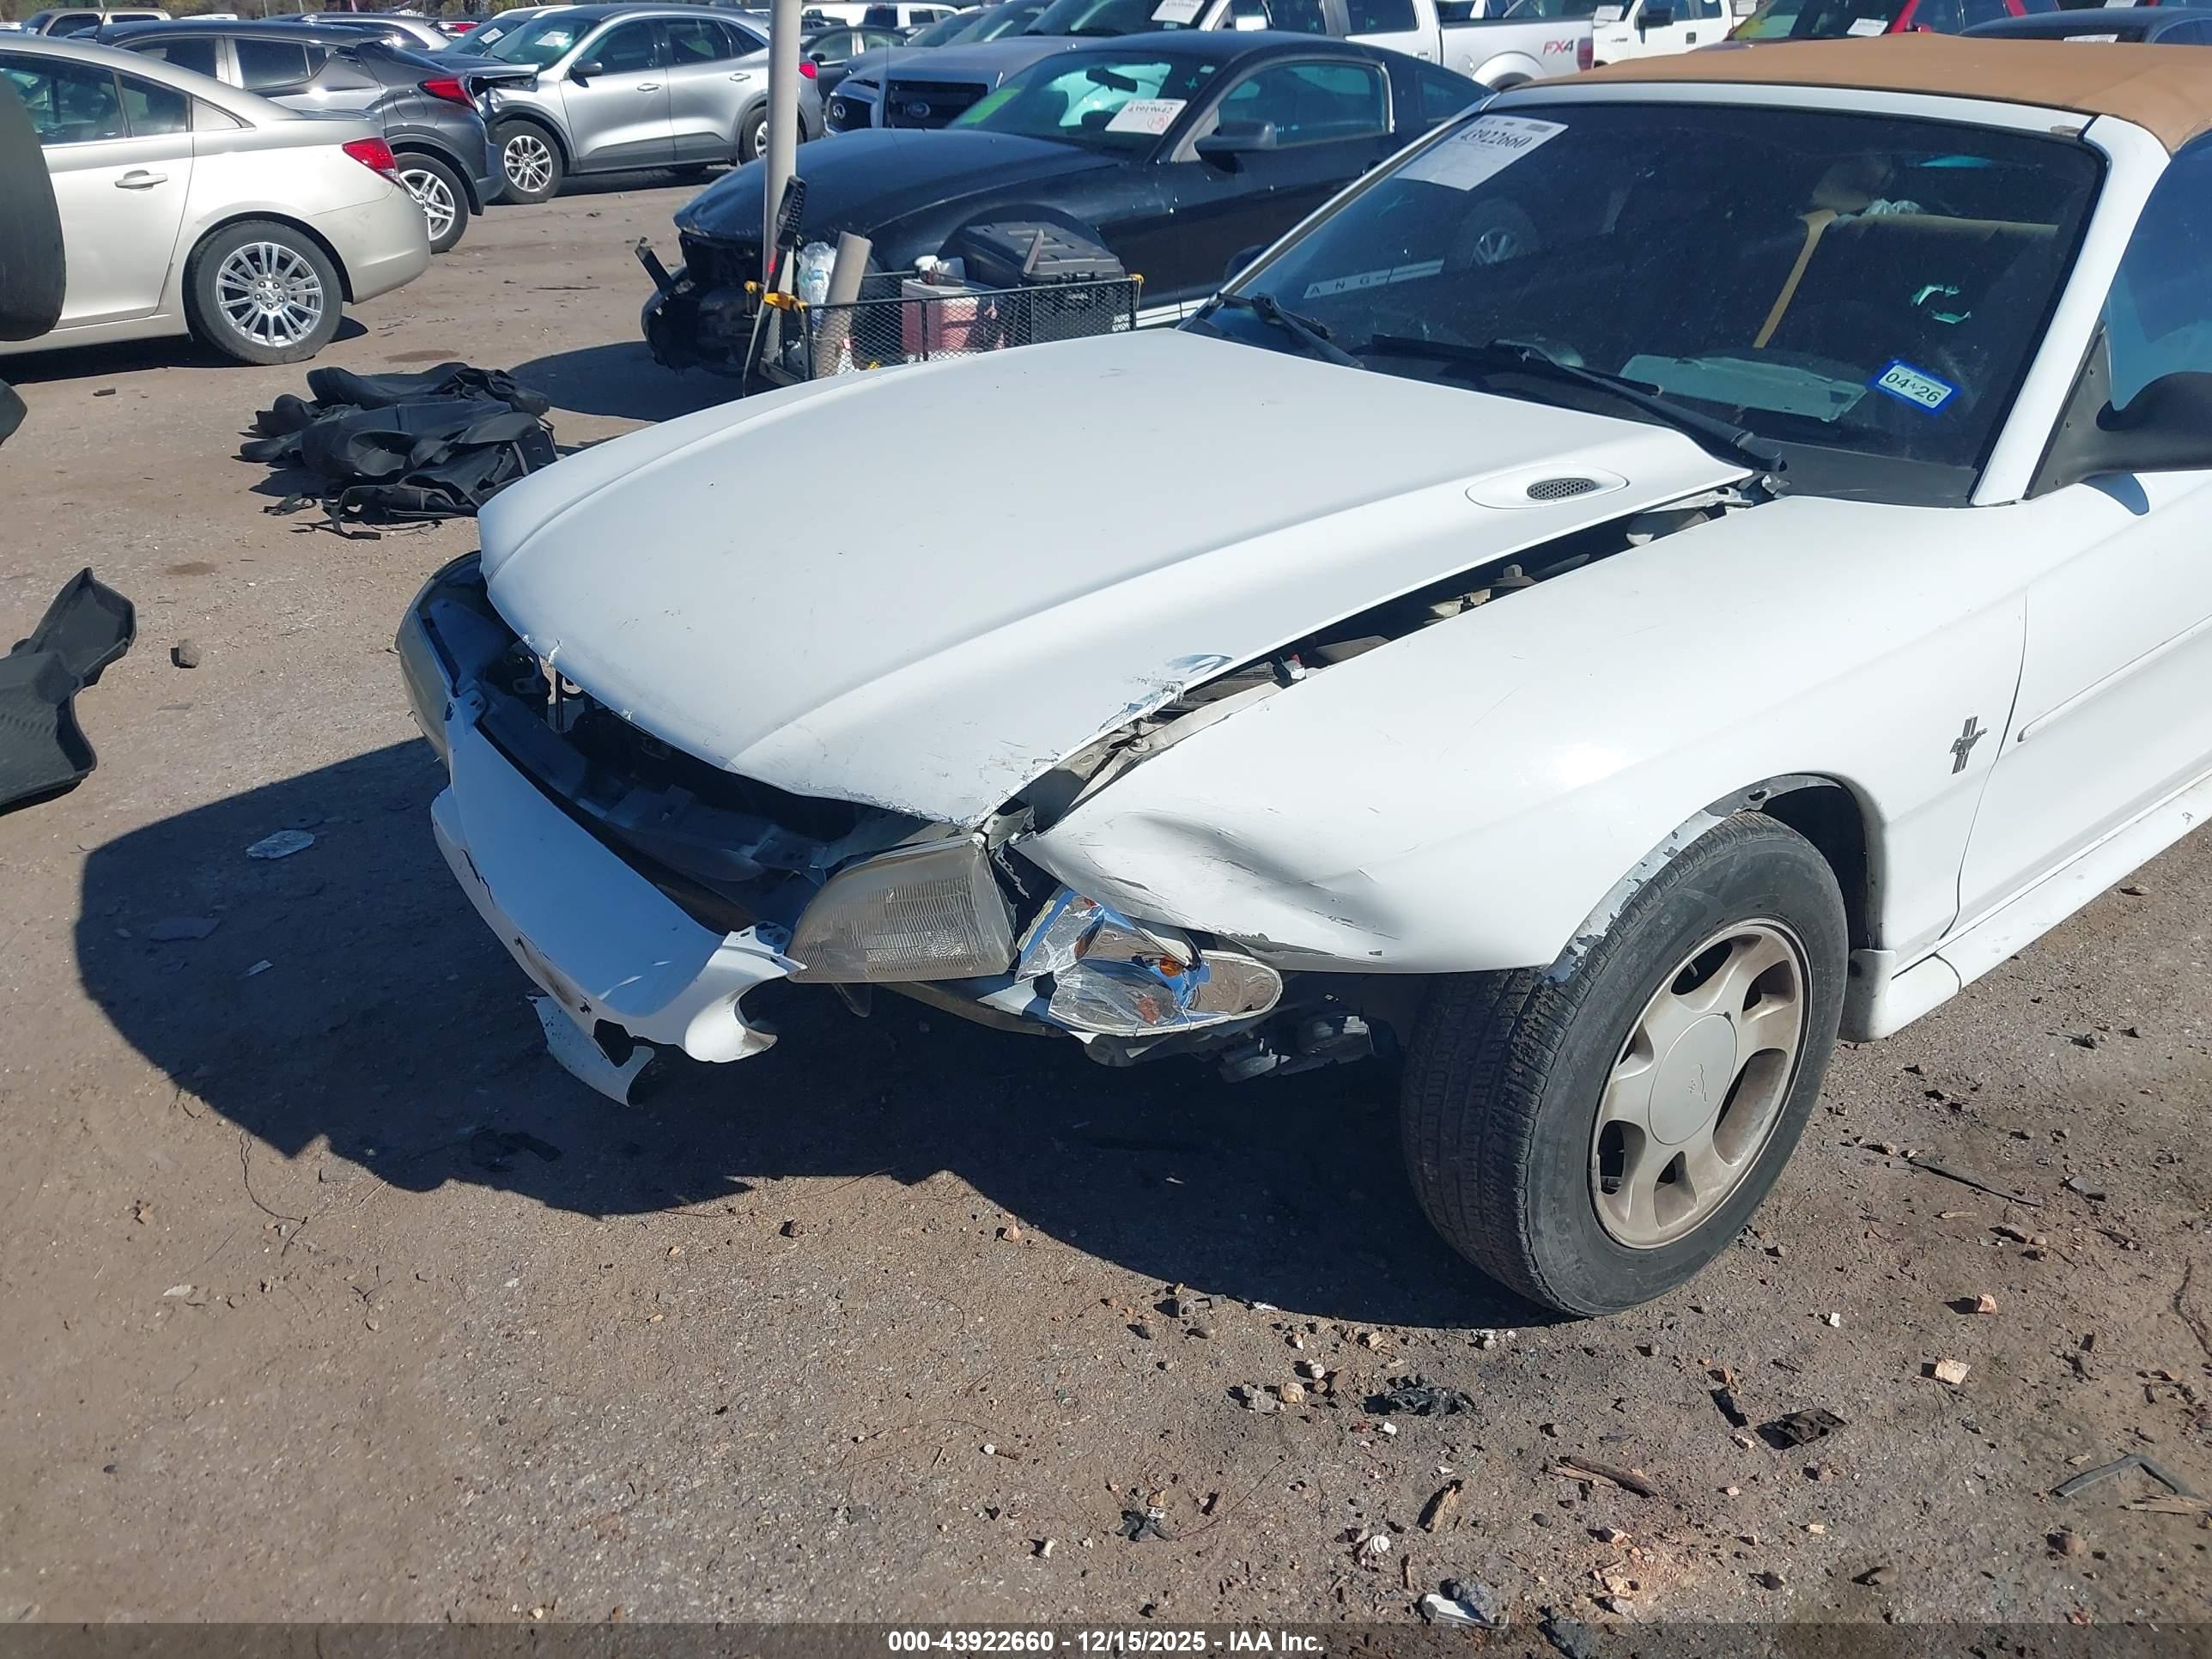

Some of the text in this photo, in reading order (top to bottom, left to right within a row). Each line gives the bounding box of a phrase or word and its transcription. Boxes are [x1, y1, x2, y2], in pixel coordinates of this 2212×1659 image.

[1543, 39, 1574, 55] FX4
[1885, 372, 1911, 389] 04
[1913, 386, 1942, 403] 26
